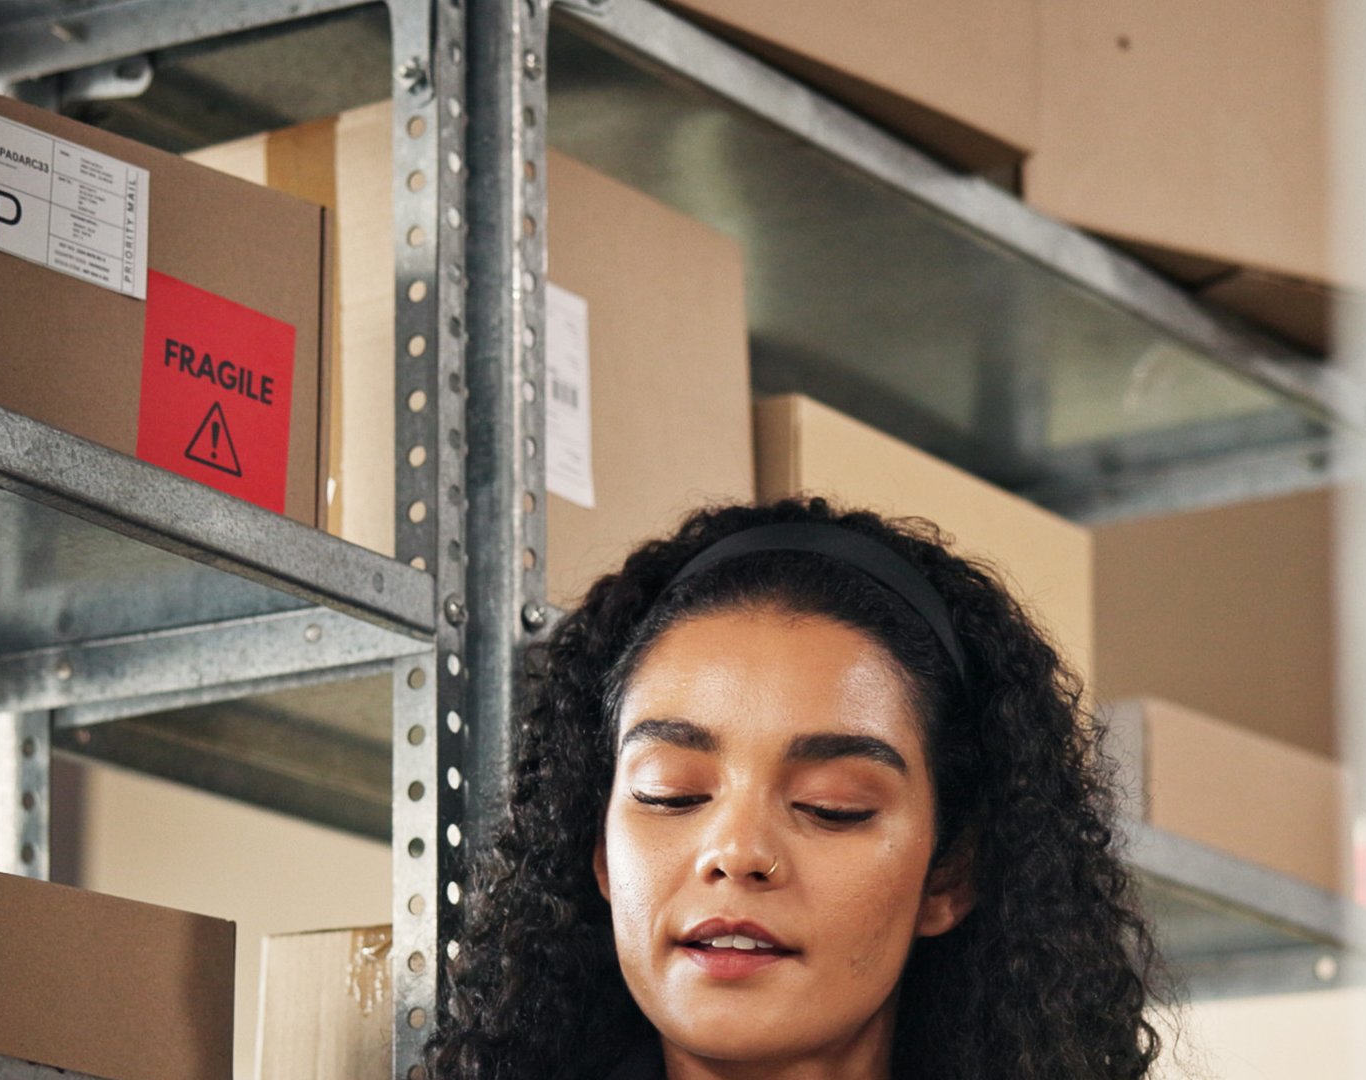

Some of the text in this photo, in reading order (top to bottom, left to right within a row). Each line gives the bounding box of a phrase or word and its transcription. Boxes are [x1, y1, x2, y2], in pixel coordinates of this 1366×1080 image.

[124, 181, 137, 284] PRIORITY MAIL
[163, 337, 275, 406] FRAGILE
